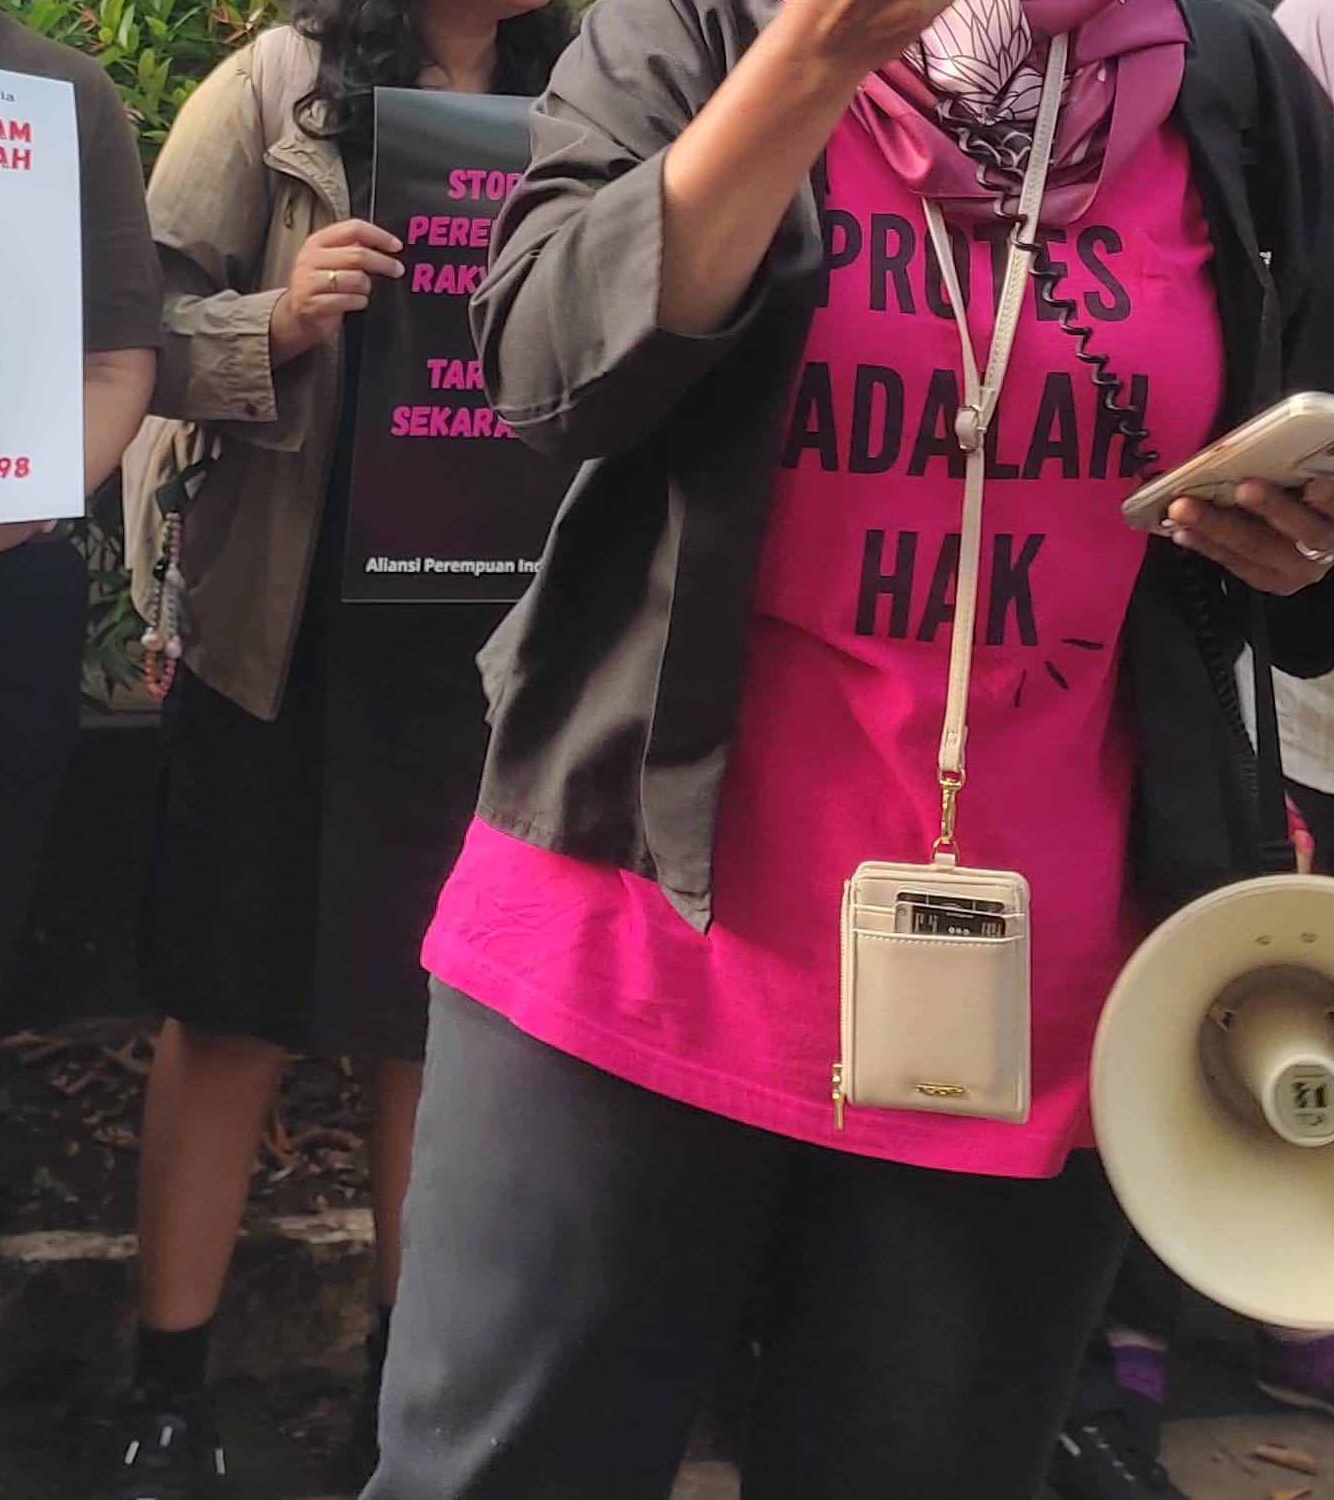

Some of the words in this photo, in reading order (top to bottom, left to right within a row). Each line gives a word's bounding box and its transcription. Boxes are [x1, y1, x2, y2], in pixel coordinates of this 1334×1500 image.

[783, 362, 1148, 480] ADALAH
[365, 557, 421, 573] Aliansi
[424, 559, 515, 577] Perempuan
